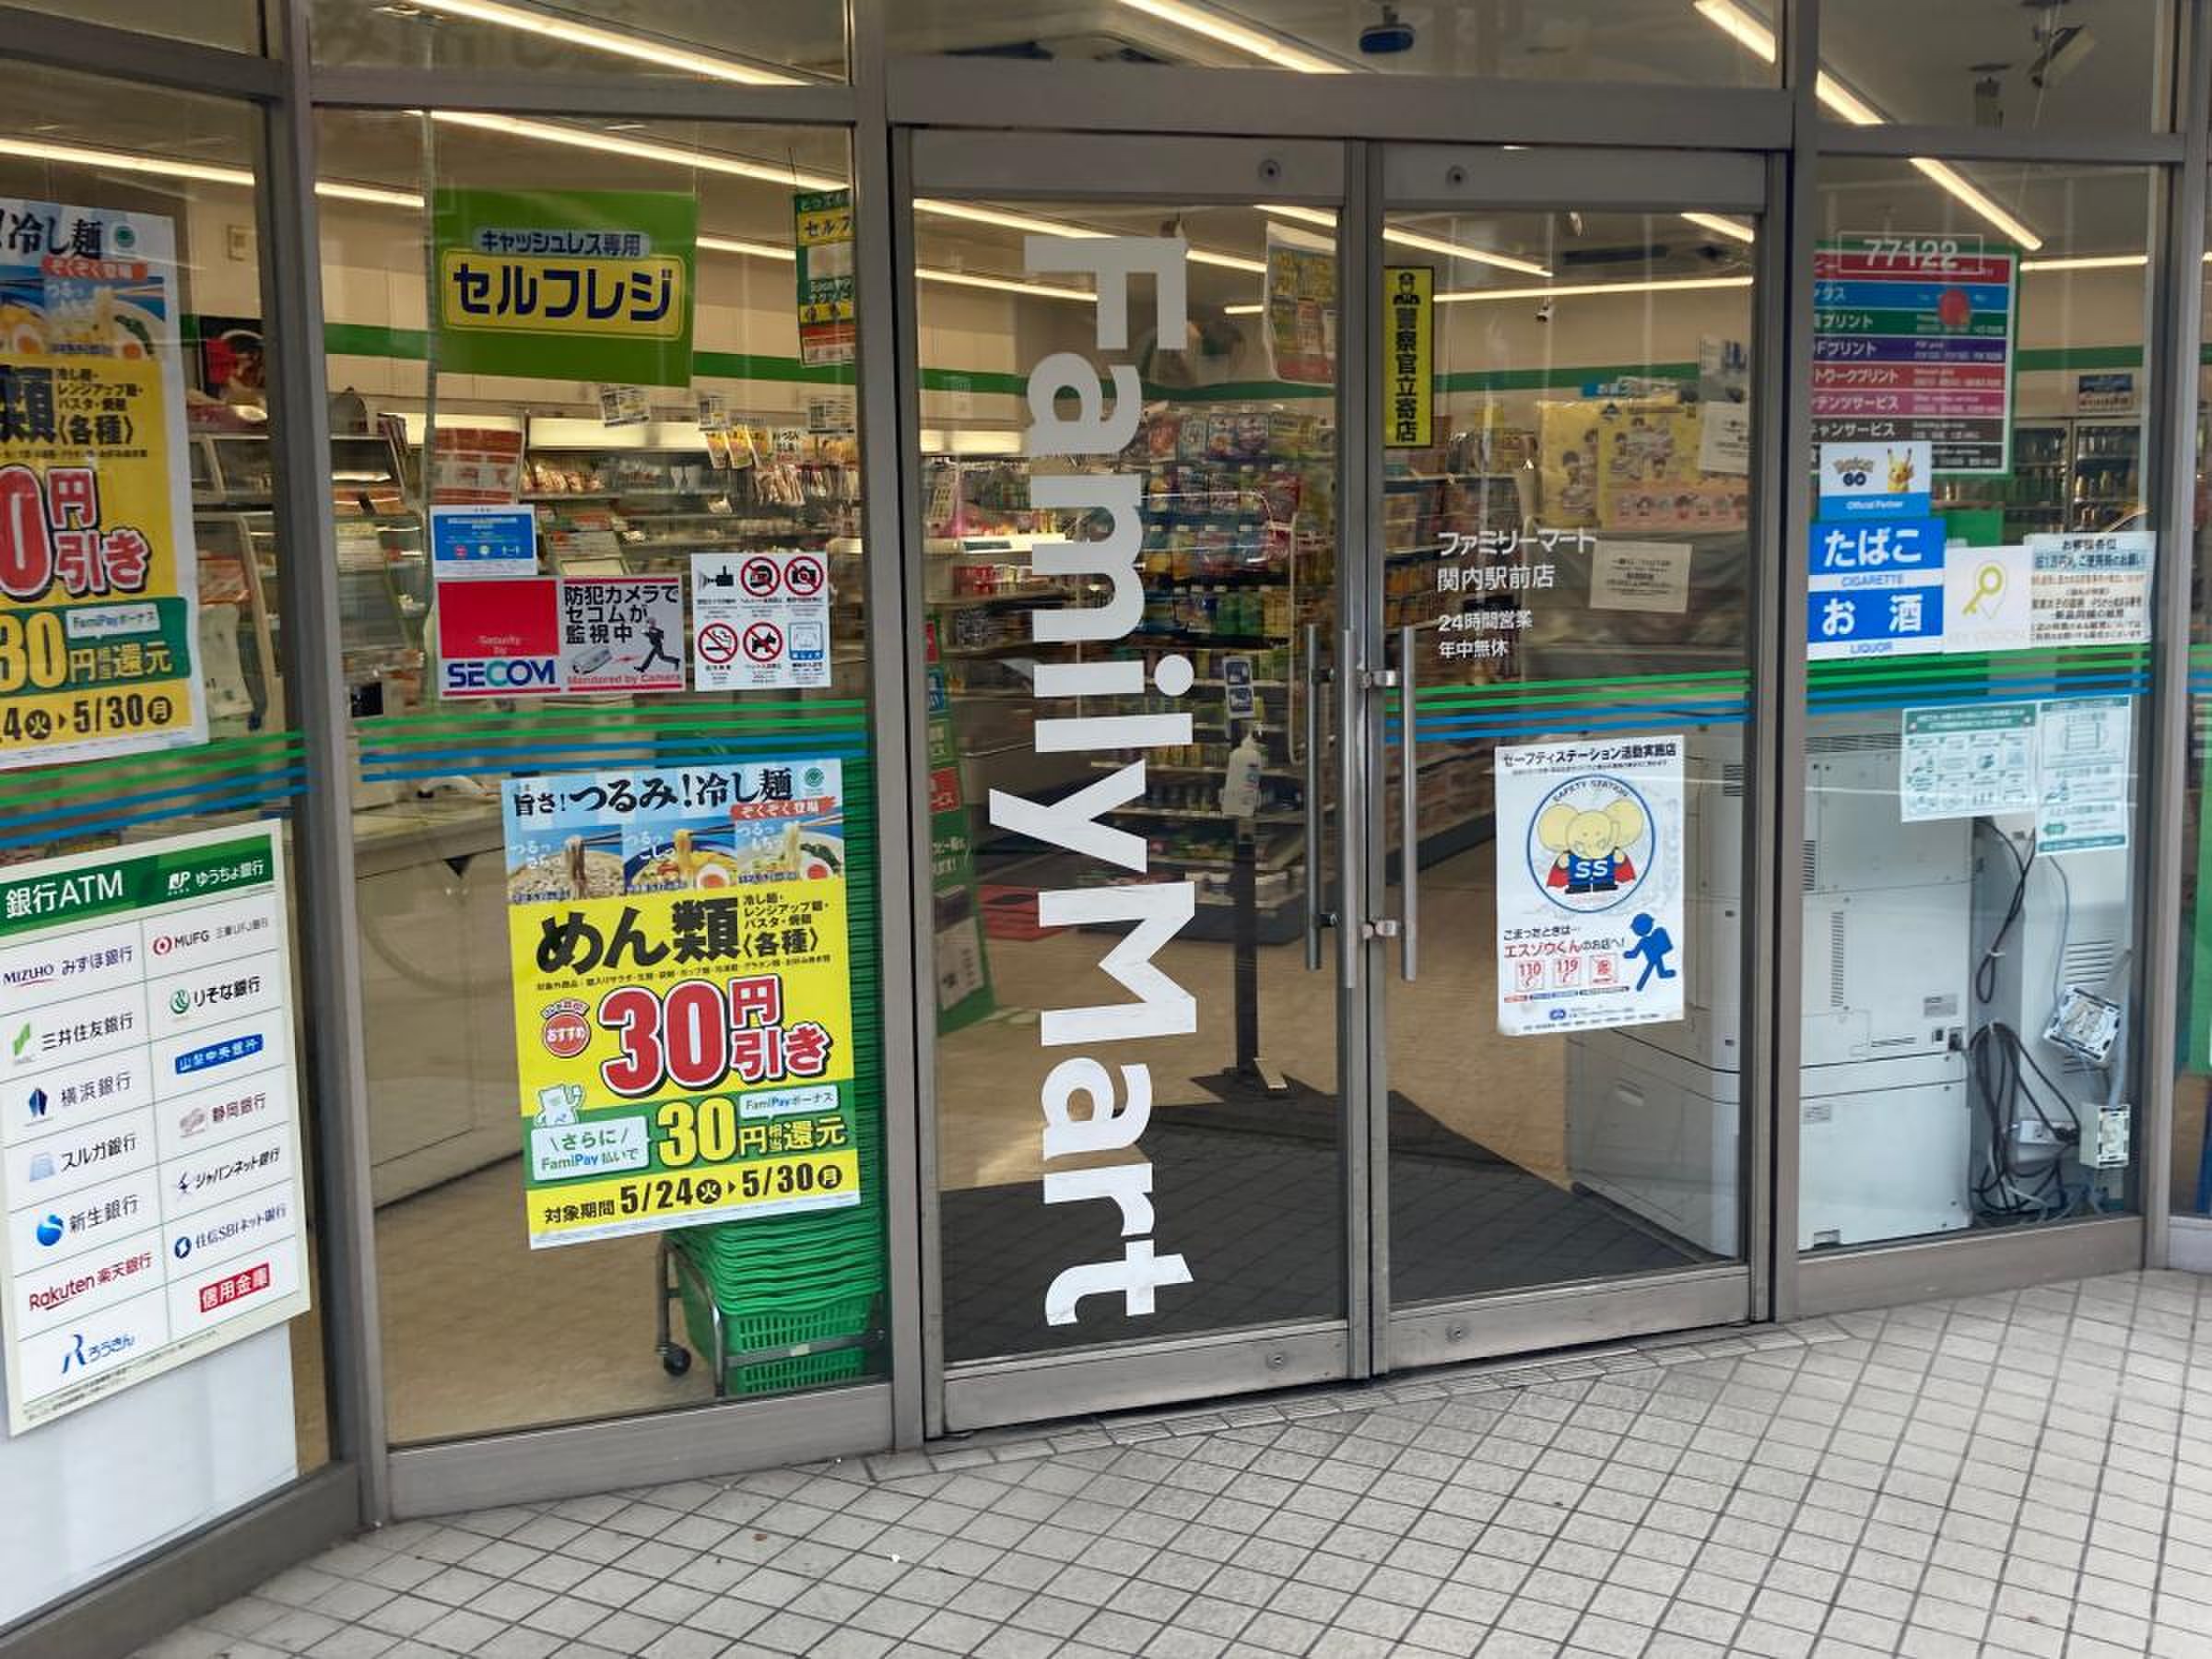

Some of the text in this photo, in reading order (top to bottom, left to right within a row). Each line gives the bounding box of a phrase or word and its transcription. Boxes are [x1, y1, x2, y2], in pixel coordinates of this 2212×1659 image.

[481, 230, 641, 255] キャッシュレス専用
[1862, 239, 1959, 269] 77122
[453, 263, 673, 322] セルフレジ
[1842, 471, 1867, 488] GO
[1438, 527, 1597, 557] ファミリーマート
[1824, 527, 1923, 568] たばこ
[1437, 564, 1555, 592] 関内駅前店
[1841, 572, 1904, 587] CIGARETTE
[563, 584, 679, 606] 防犯カメラで
[565, 604, 647, 624] セコムが
[1438, 609, 1534, 632] 24時間営業
[565, 624, 633, 645] 監視中
[1438, 638, 1509, 660] 年中無休
[1850, 642, 1894, 655] LIQUOR
[448, 658, 556, 688] SECOM
[989, 236, 1197, 1327] FamilyMart
[195, 859, 265, 888] ゆうちょ銀行
[1574, 860, 1609, 878] SS
[6, 869, 124, 919] 銀行ATM
[174, 929, 211, 948] MUFG
[536, 896, 745, 975] めん類
[3, 945, 134, 985] MIZUHO みずほ銀行
[194, 975, 262, 1007] りそな銀行
[41, 1012, 134, 1052] 三井住友銀行
[599, 974, 782, 1097] 30 円
[731, 1020, 833, 1084] 引き
[61, 1071, 133, 1108] 横浜銀行
[657, 1096, 738, 1168] 30
[61, 1132, 136, 1171] スルガ銀行
[541, 1153, 599, 1171] FamiPay
[545, 1199, 616, 1225] 対象期間
[619, 1177, 694, 1214] 5/24
[742, 1161, 814, 1198] 5/30
[69, 1194, 138, 1233] 新生銀行
[29, 1252, 153, 1312] Rakuten 楽天銀行
